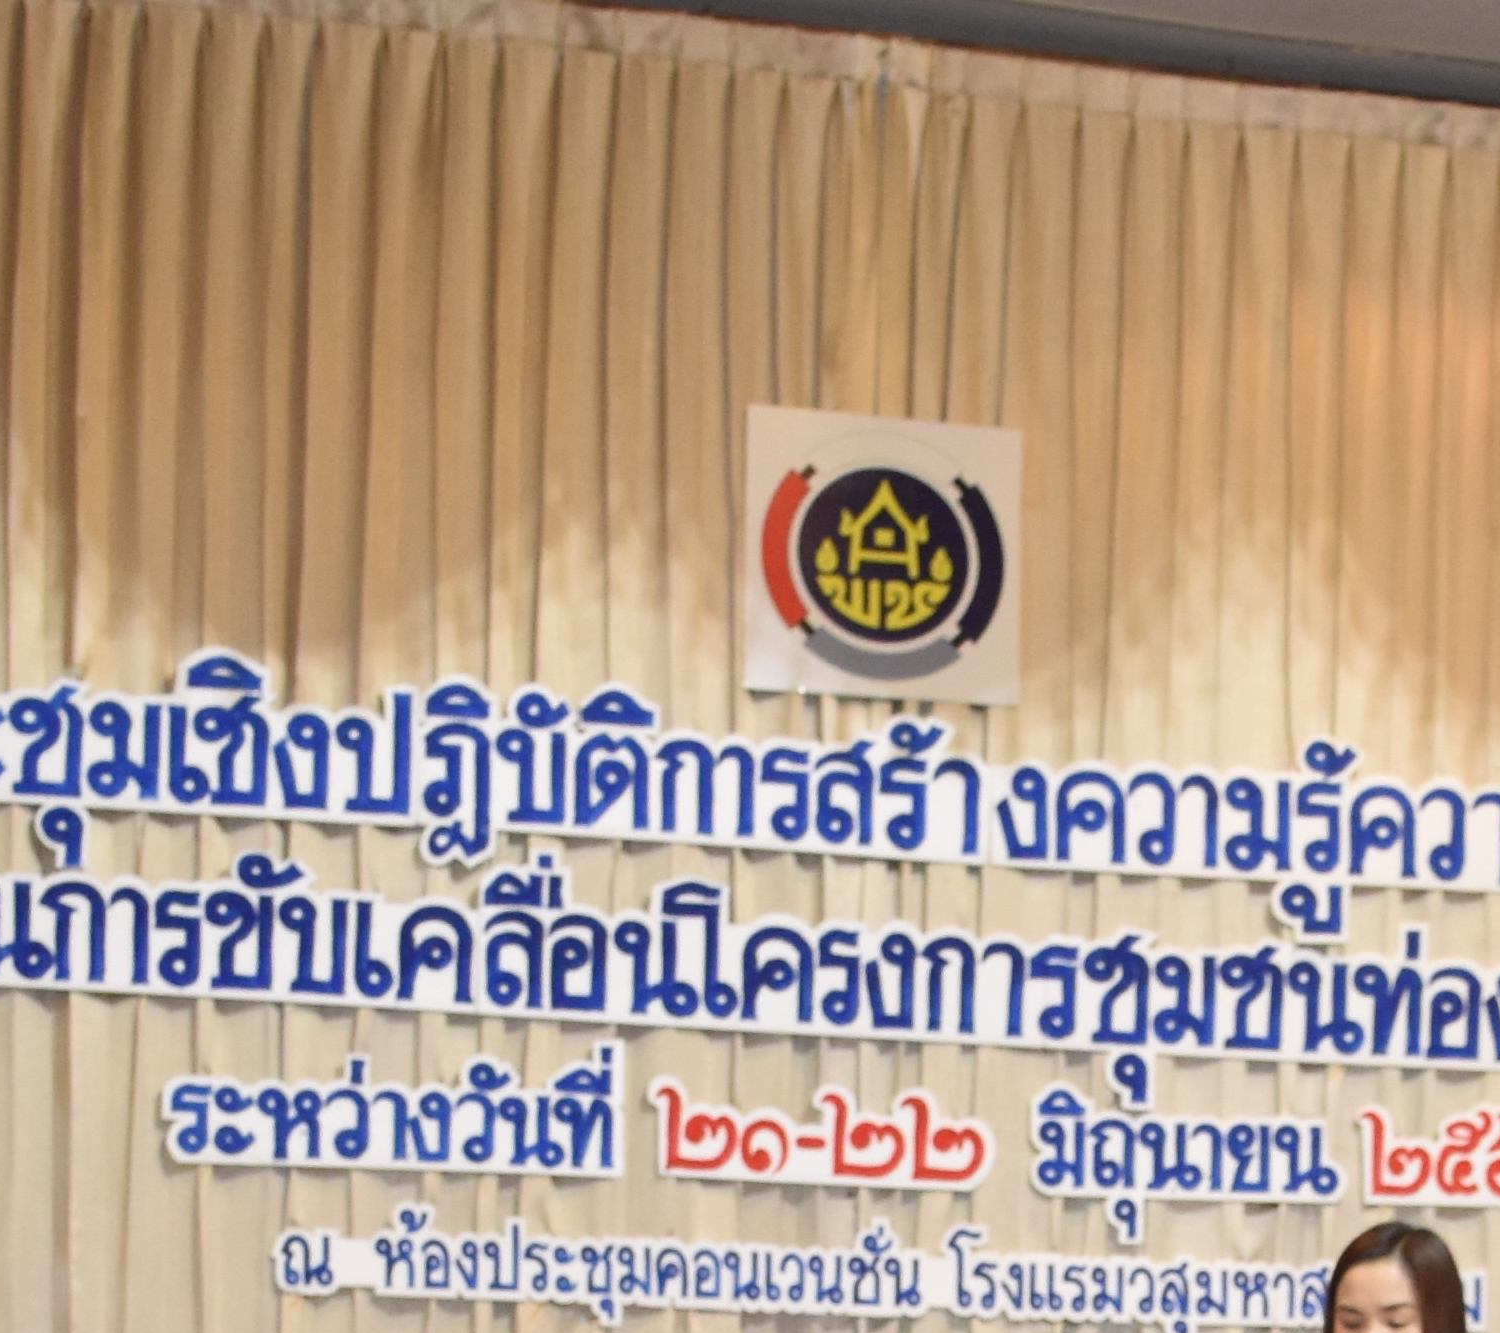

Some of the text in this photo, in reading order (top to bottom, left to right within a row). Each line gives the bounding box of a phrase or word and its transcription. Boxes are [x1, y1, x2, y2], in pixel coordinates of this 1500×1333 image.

[170, 1047, 614, 1169] ระหว่างวันที่
[658, 1087, 984, 1181] ๒๑-๒๒
[1038, 1089, 1338, 1237] มิถุนายน
[282, 1234, 332, 1286] ณ
[374, 1210, 921, 1317] ห้องประชุมคอนเวนชั่น
